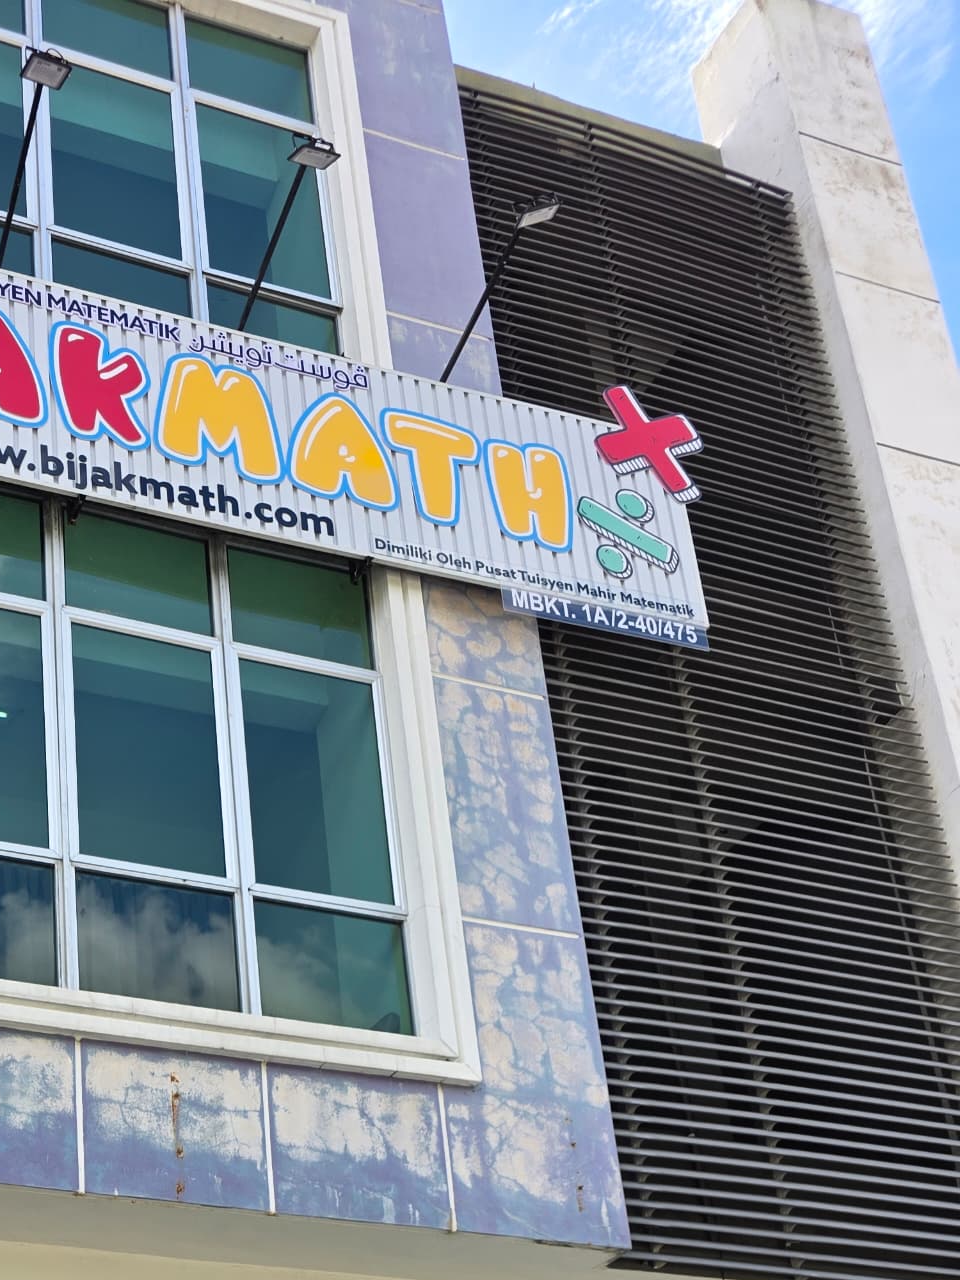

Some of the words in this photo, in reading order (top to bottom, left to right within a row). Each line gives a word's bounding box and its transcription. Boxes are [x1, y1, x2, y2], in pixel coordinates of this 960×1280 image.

[47, 293, 180, 342] MATEMATIK
[374, 537, 432, 561] Dimiliki
[436, 552, 471, 570] Oleh
[475, 560, 517, 580] Pusat
[518, 570, 573, 594] Tuisyen
[577, 582, 617, 601] Mahir
[620, 591, 695, 617] Matematik
[511, 589, 577, 619] MBKT.
